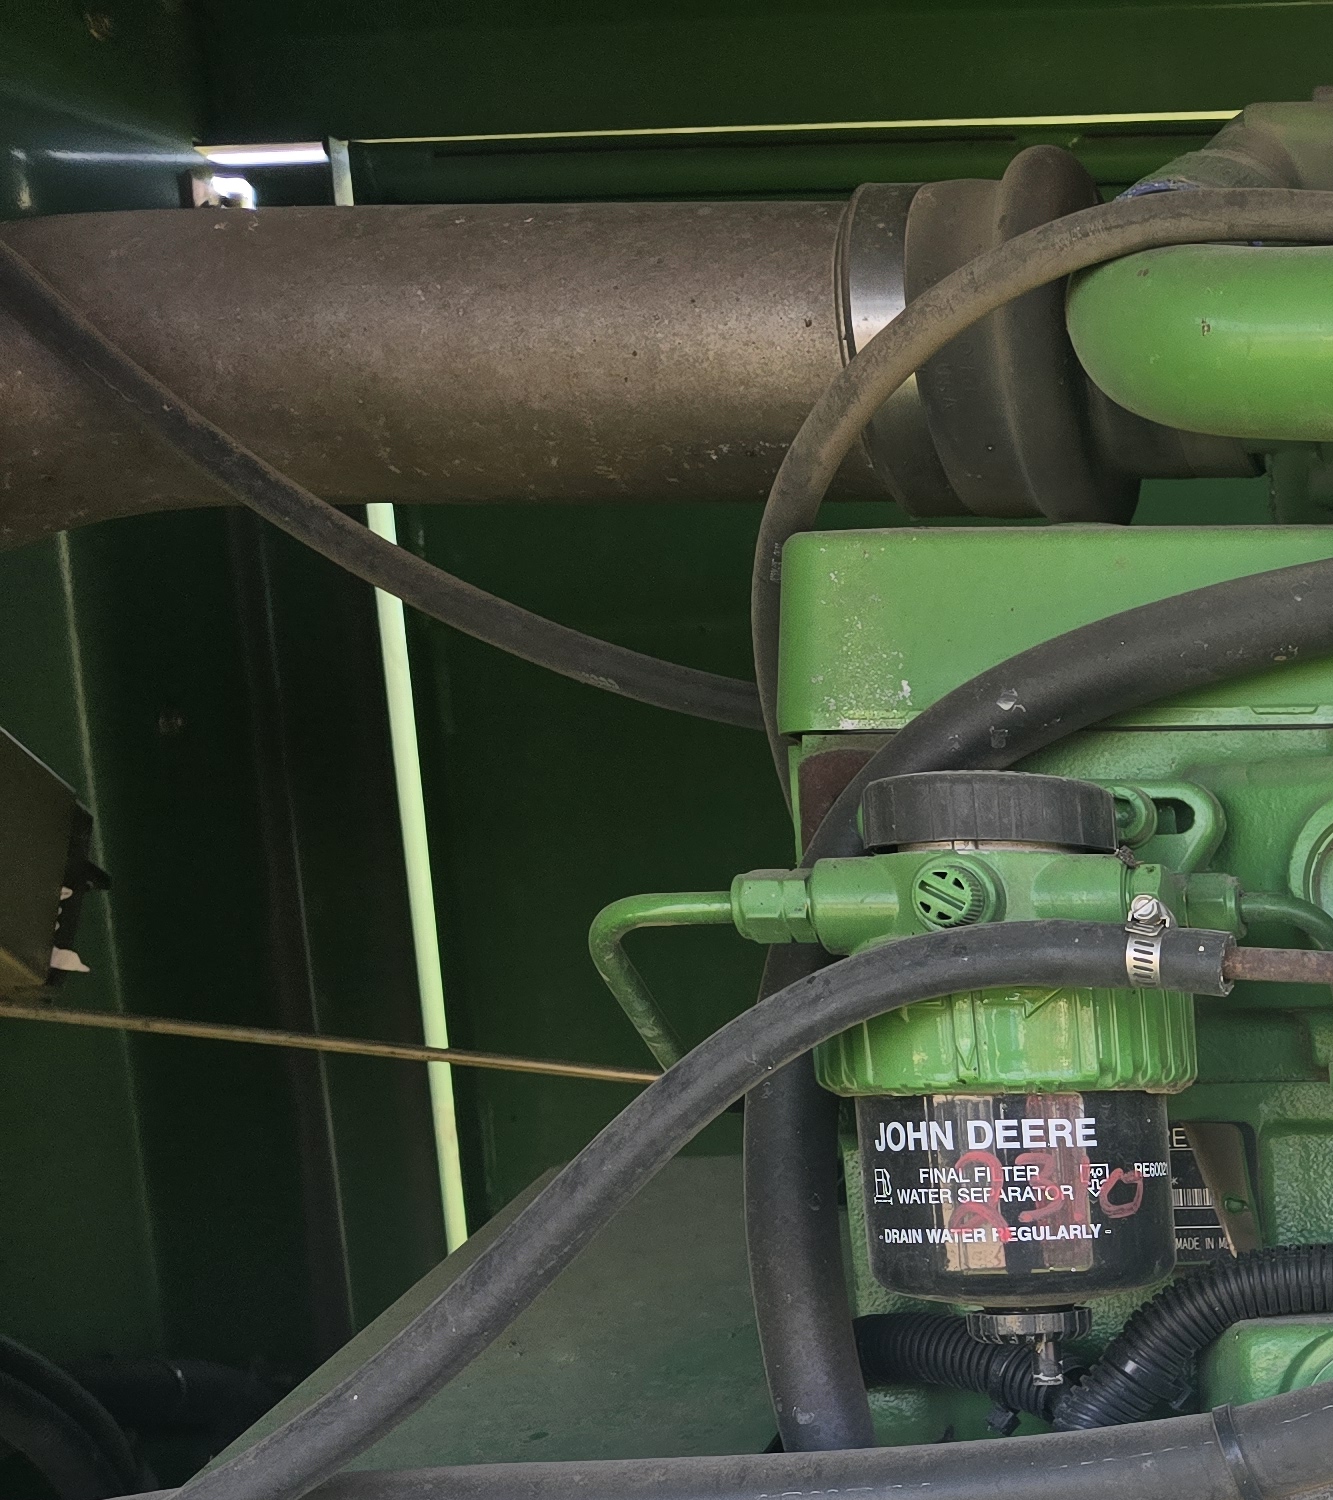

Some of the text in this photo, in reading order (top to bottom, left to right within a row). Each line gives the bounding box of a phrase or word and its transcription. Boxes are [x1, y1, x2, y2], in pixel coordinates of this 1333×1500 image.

[873, 1117, 1098, 1152] JOHN DEERE
[919, 1165, 1040, 1184] FINAL FILTER
[896, 1184, 1075, 1205] WATER SEPARATOR
[925, 1227, 987, 1243] WATER
[990, 1223, 1103, 1243] REGULARLY
[1174, 1237, 1200, 1250] MADE
[1204, 1237, 1215, 1249] IN
